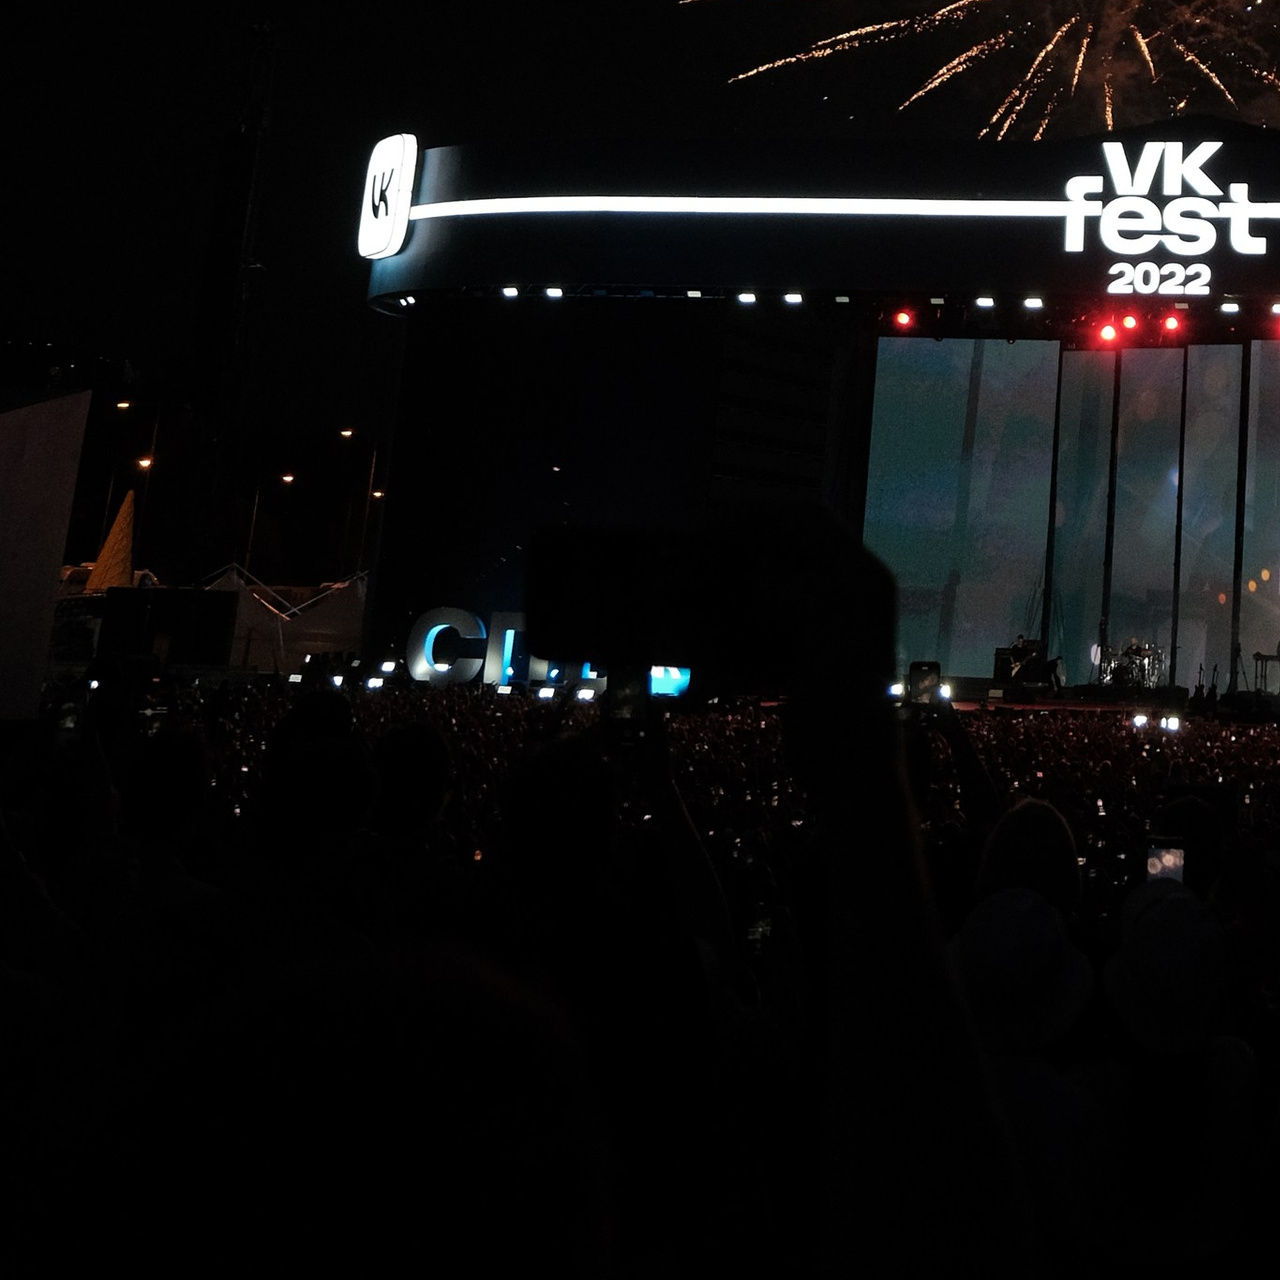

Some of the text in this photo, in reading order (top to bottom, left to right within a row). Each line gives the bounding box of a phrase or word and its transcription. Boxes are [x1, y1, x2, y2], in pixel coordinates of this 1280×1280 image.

[1102, 141, 1225, 196] VK
[1065, 175, 1267, 256] fest
[1107, 261, 1212, 296] 2022
